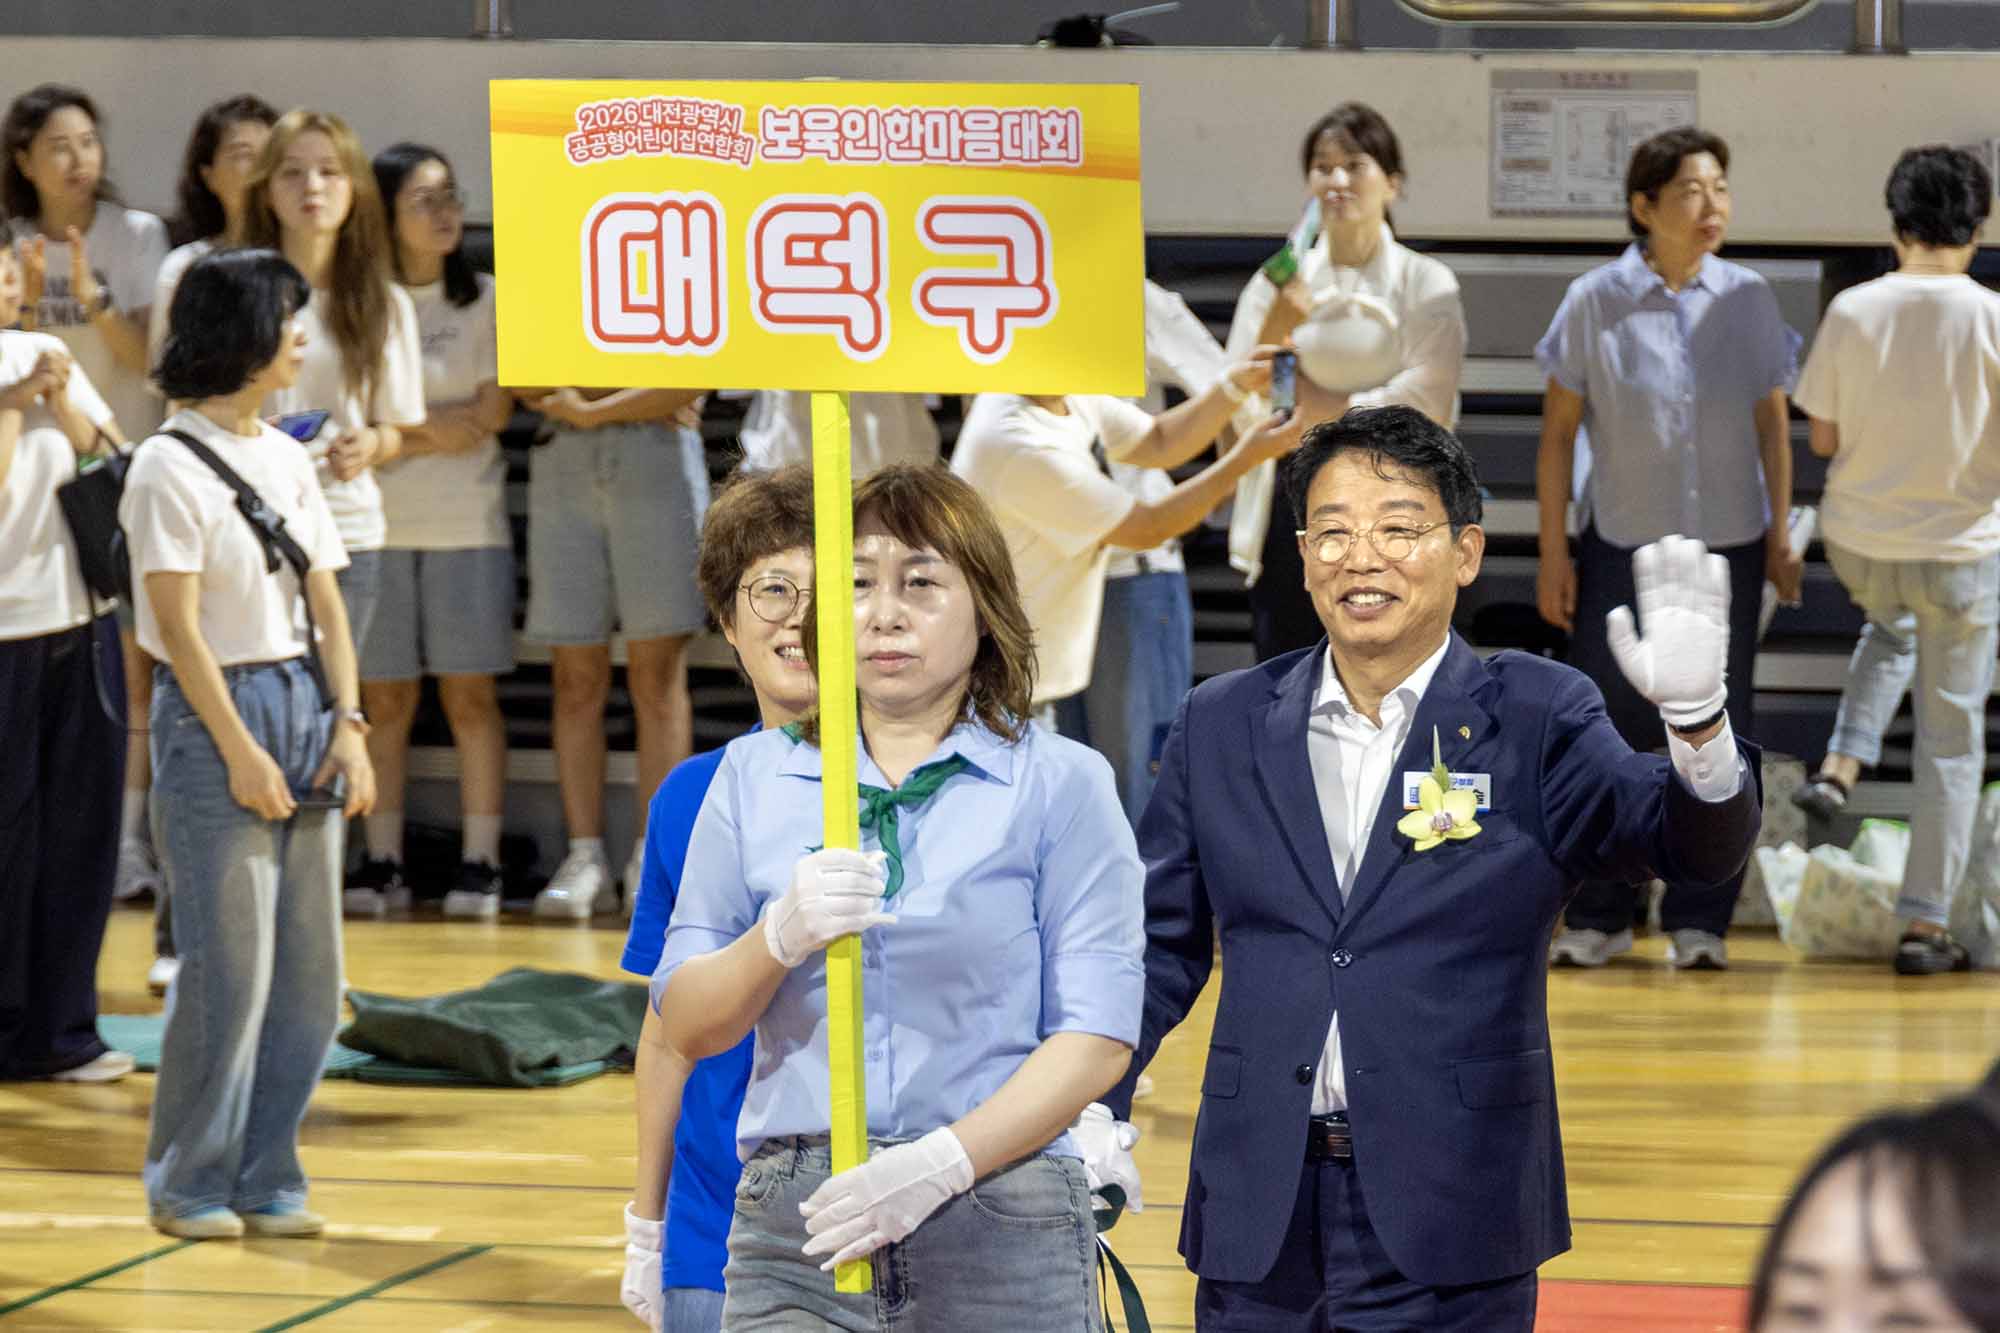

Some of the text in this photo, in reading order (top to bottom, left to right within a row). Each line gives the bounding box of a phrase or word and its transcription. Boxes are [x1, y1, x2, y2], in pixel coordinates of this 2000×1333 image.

[581, 100, 740, 134] 2026 대전광역시
[569, 127, 754, 165] 공공형어린이집연합회
[589, 198, 1052, 355] 대덕구
